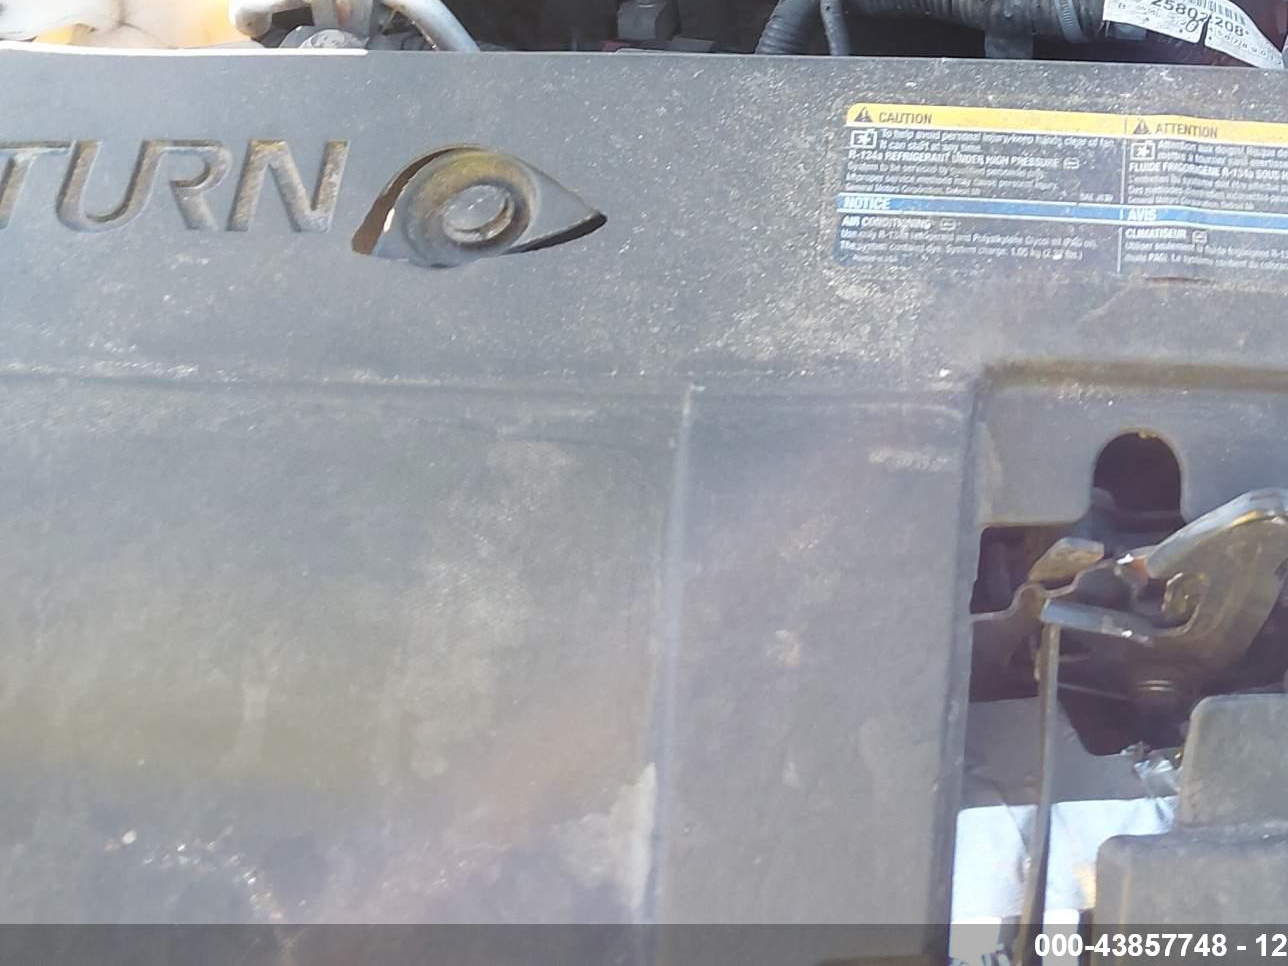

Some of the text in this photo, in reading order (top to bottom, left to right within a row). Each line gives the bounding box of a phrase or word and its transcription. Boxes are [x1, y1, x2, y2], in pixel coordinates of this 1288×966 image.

[878, 112, 932, 124] CAUTION
[1155, 122, 1218, 139] ATTENTION
[884, 151, 950, 163] REFRIGERANT
[1011, 156, 1060, 168] PRESSURE
[1128, 162, 1162, 172] FLUIDE
[0, 138, 350, 232] TURN
[844, 196, 891, 210] NOTICE
[842, 216, 860, 227] AIR
[1128, 208, 1158, 222] AVIS
